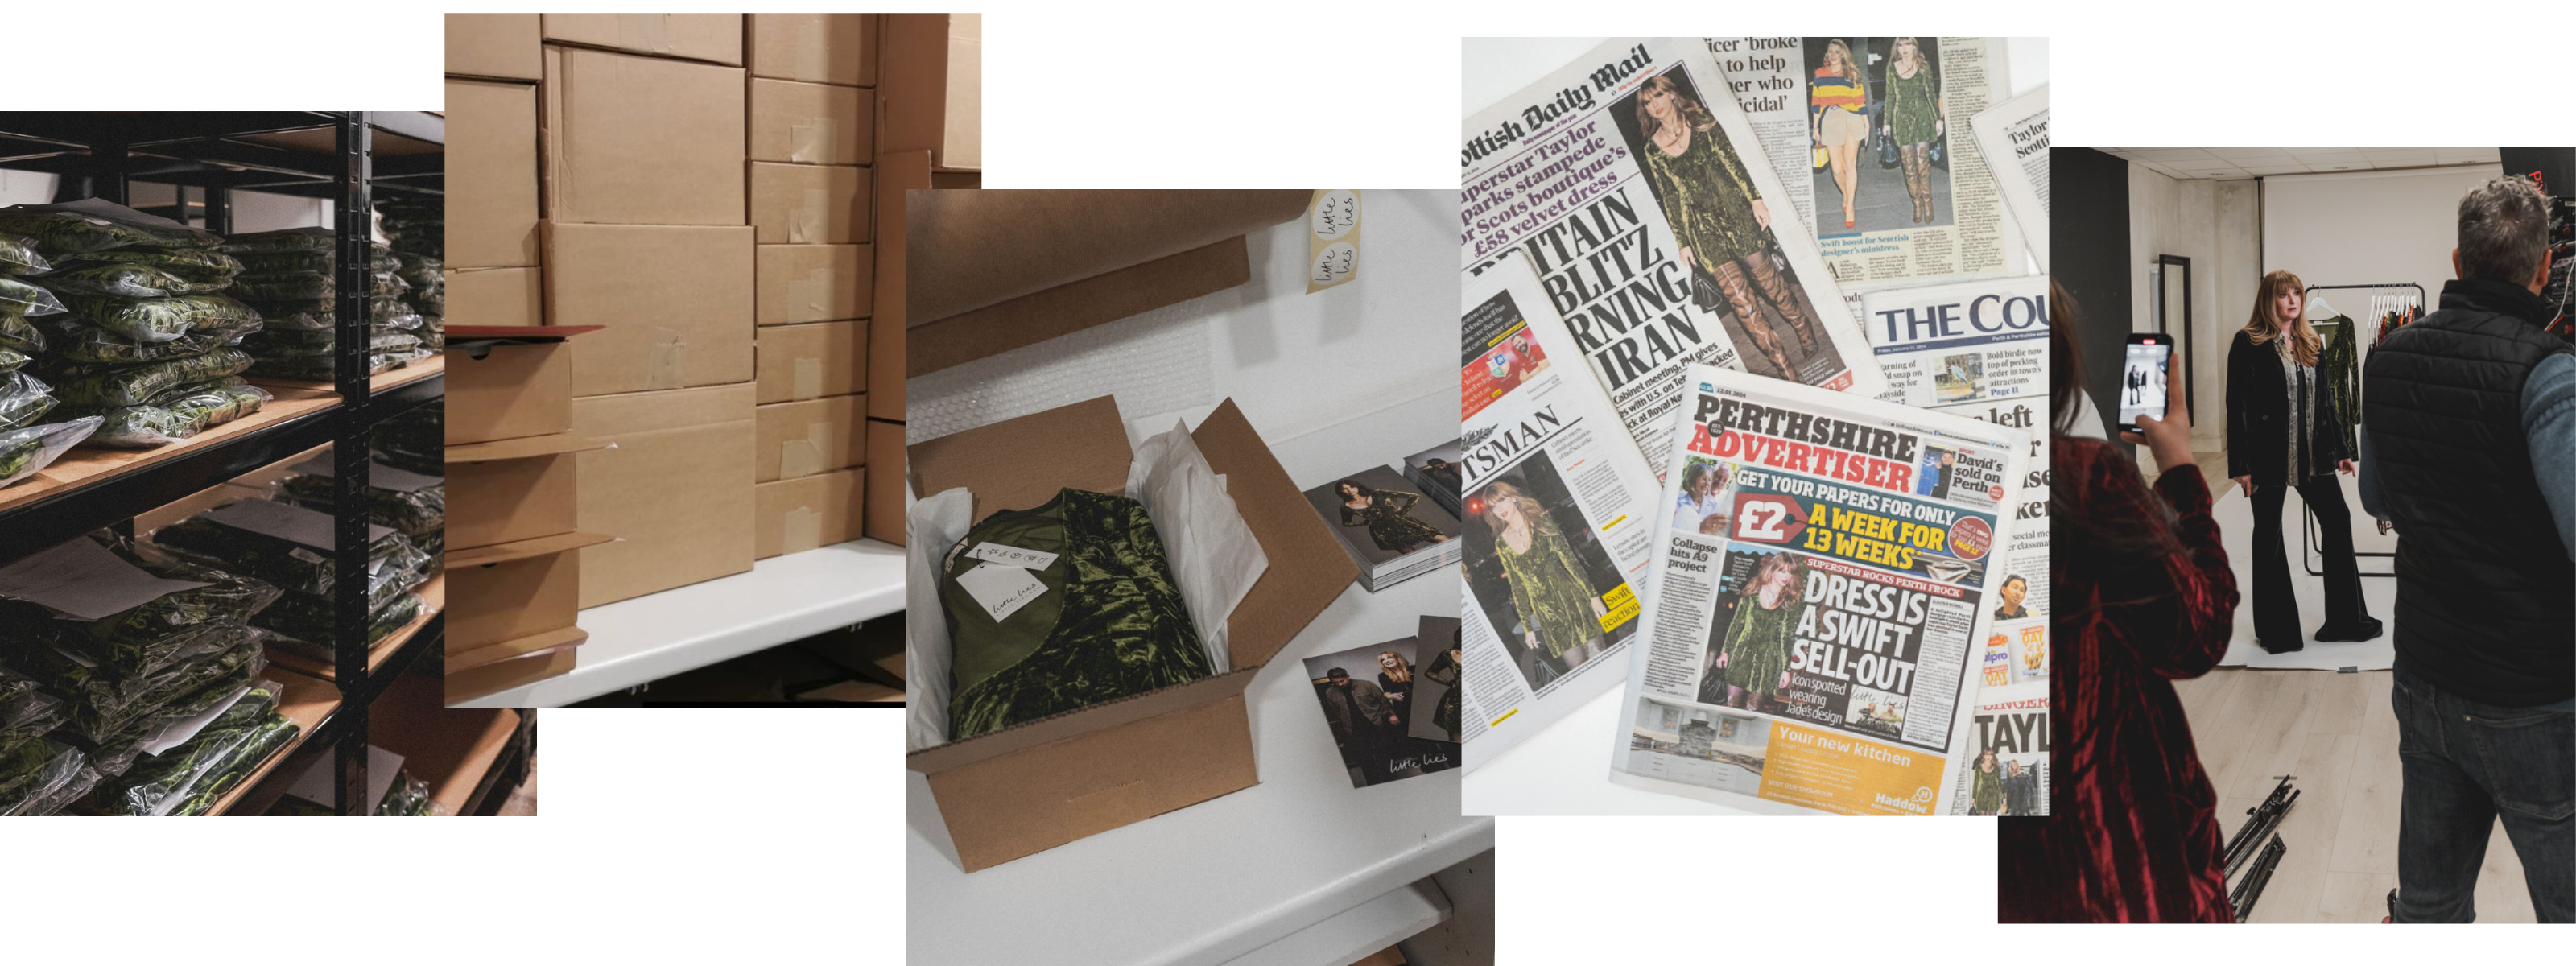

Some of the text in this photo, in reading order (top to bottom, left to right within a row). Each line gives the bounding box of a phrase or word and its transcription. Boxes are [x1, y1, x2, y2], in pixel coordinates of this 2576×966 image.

[1726, 55, 1786, 72] to help
[1521, 85, 1596, 132] Daily
[1589, 43, 1653, 92] Mail
[1757, 75, 1794, 91] who
[1534, 120, 1596, 163] Taylor
[2008, 121, 2047, 145] Taylor
[1515, 136, 1606, 194] stampede
[1317, 197, 1335, 234] little
[1338, 197, 1353, 226] lies
[1474, 171, 1618, 258] £58 velvet dress
[1476, 200, 1529, 234] Scots
[1878, 234, 1909, 242] Scottish
[1861, 245, 1900, 254] minidress
[1315, 250, 1335, 281] little
[1335, 250, 1352, 274] lies
[1543, 224, 1665, 316] BLITZ
[1876, 303, 1964, 342] THE
[1596, 305, 1703, 391] IRAN
[1987, 352, 2004, 360] Bold
[2004, 349, 2026, 358] birdie
[1613, 382, 1645, 404] Cabinet
[1645, 364, 1682, 390] meeting,
[1679, 354, 1696, 368] PM
[1695, 341, 1719, 361] gives
[1909, 359, 1917, 369] of
[1988, 357, 2038, 370] top of pecking
[1988, 369, 2009, 378] order
[1890, 381, 1905, 389] way
[1893, 370, 1912, 381] snap
[1989, 378, 2029, 386] attractions
[1629, 398, 1648, 412] with
[1662, 385, 1674, 394] on
[1990, 388, 2009, 397] Page
[1638, 399, 1672, 423] at Royal
[1990, 404, 2034, 428] left
[1694, 394, 1918, 464] PERTHSHIRE
[1462, 403, 1561, 482] TSMAN
[1687, 423, 1913, 493] ADVERTISER
[1951, 477, 1988, 493] Perth
[1954, 465, 2000, 484] sold on
[1736, 469, 1957, 526] GET YOUR PAPERS FOR ONLY
[1738, 500, 1946, 552] £2 A WEEK FOR
[2013, 530, 2035, 540] social
[1673, 536, 1717, 554] Collapse
[1803, 526, 1833, 553] 13
[2016, 540, 2050, 550] classma
[1668, 558, 1707, 573] project
[1670, 547, 1708, 563] hits A9
[1807, 559, 1960, 597] SUPERSTAR ROCKS PERTH FROCK
[1605, 584, 1632, 607] Swift
[1804, 570, 1897, 619] DRESS
[1897, 590, 1927, 625] IS
[1603, 602, 1641, 630] reaction
[1795, 605, 1817, 639] A
[1818, 609, 1913, 658] SWIFT
[2021, 632, 2044, 644] OAT
[1790, 638, 1916, 694] SELL-OUT
[1985, 651, 2008, 663] alpro
[1991, 664, 2008, 672] SUGARS
[1791, 674, 1847, 696] Icon spotted
[1986, 671, 2008, 683] OAT
[1789, 690, 1827, 708] wearing
[1812, 708, 1843, 725] design
[1975, 712, 2050, 754] TAYL
[1777, 741, 1799, 751] Design
[1779, 725, 1911, 767] Your new kitchen
[1390, 753, 1448, 773] little lies
[1768, 779, 1833, 799] VISIT OUR SHOWROOM
[1920, 790, 1929, 799] H
[1875, 792, 1927, 814] Haddow
